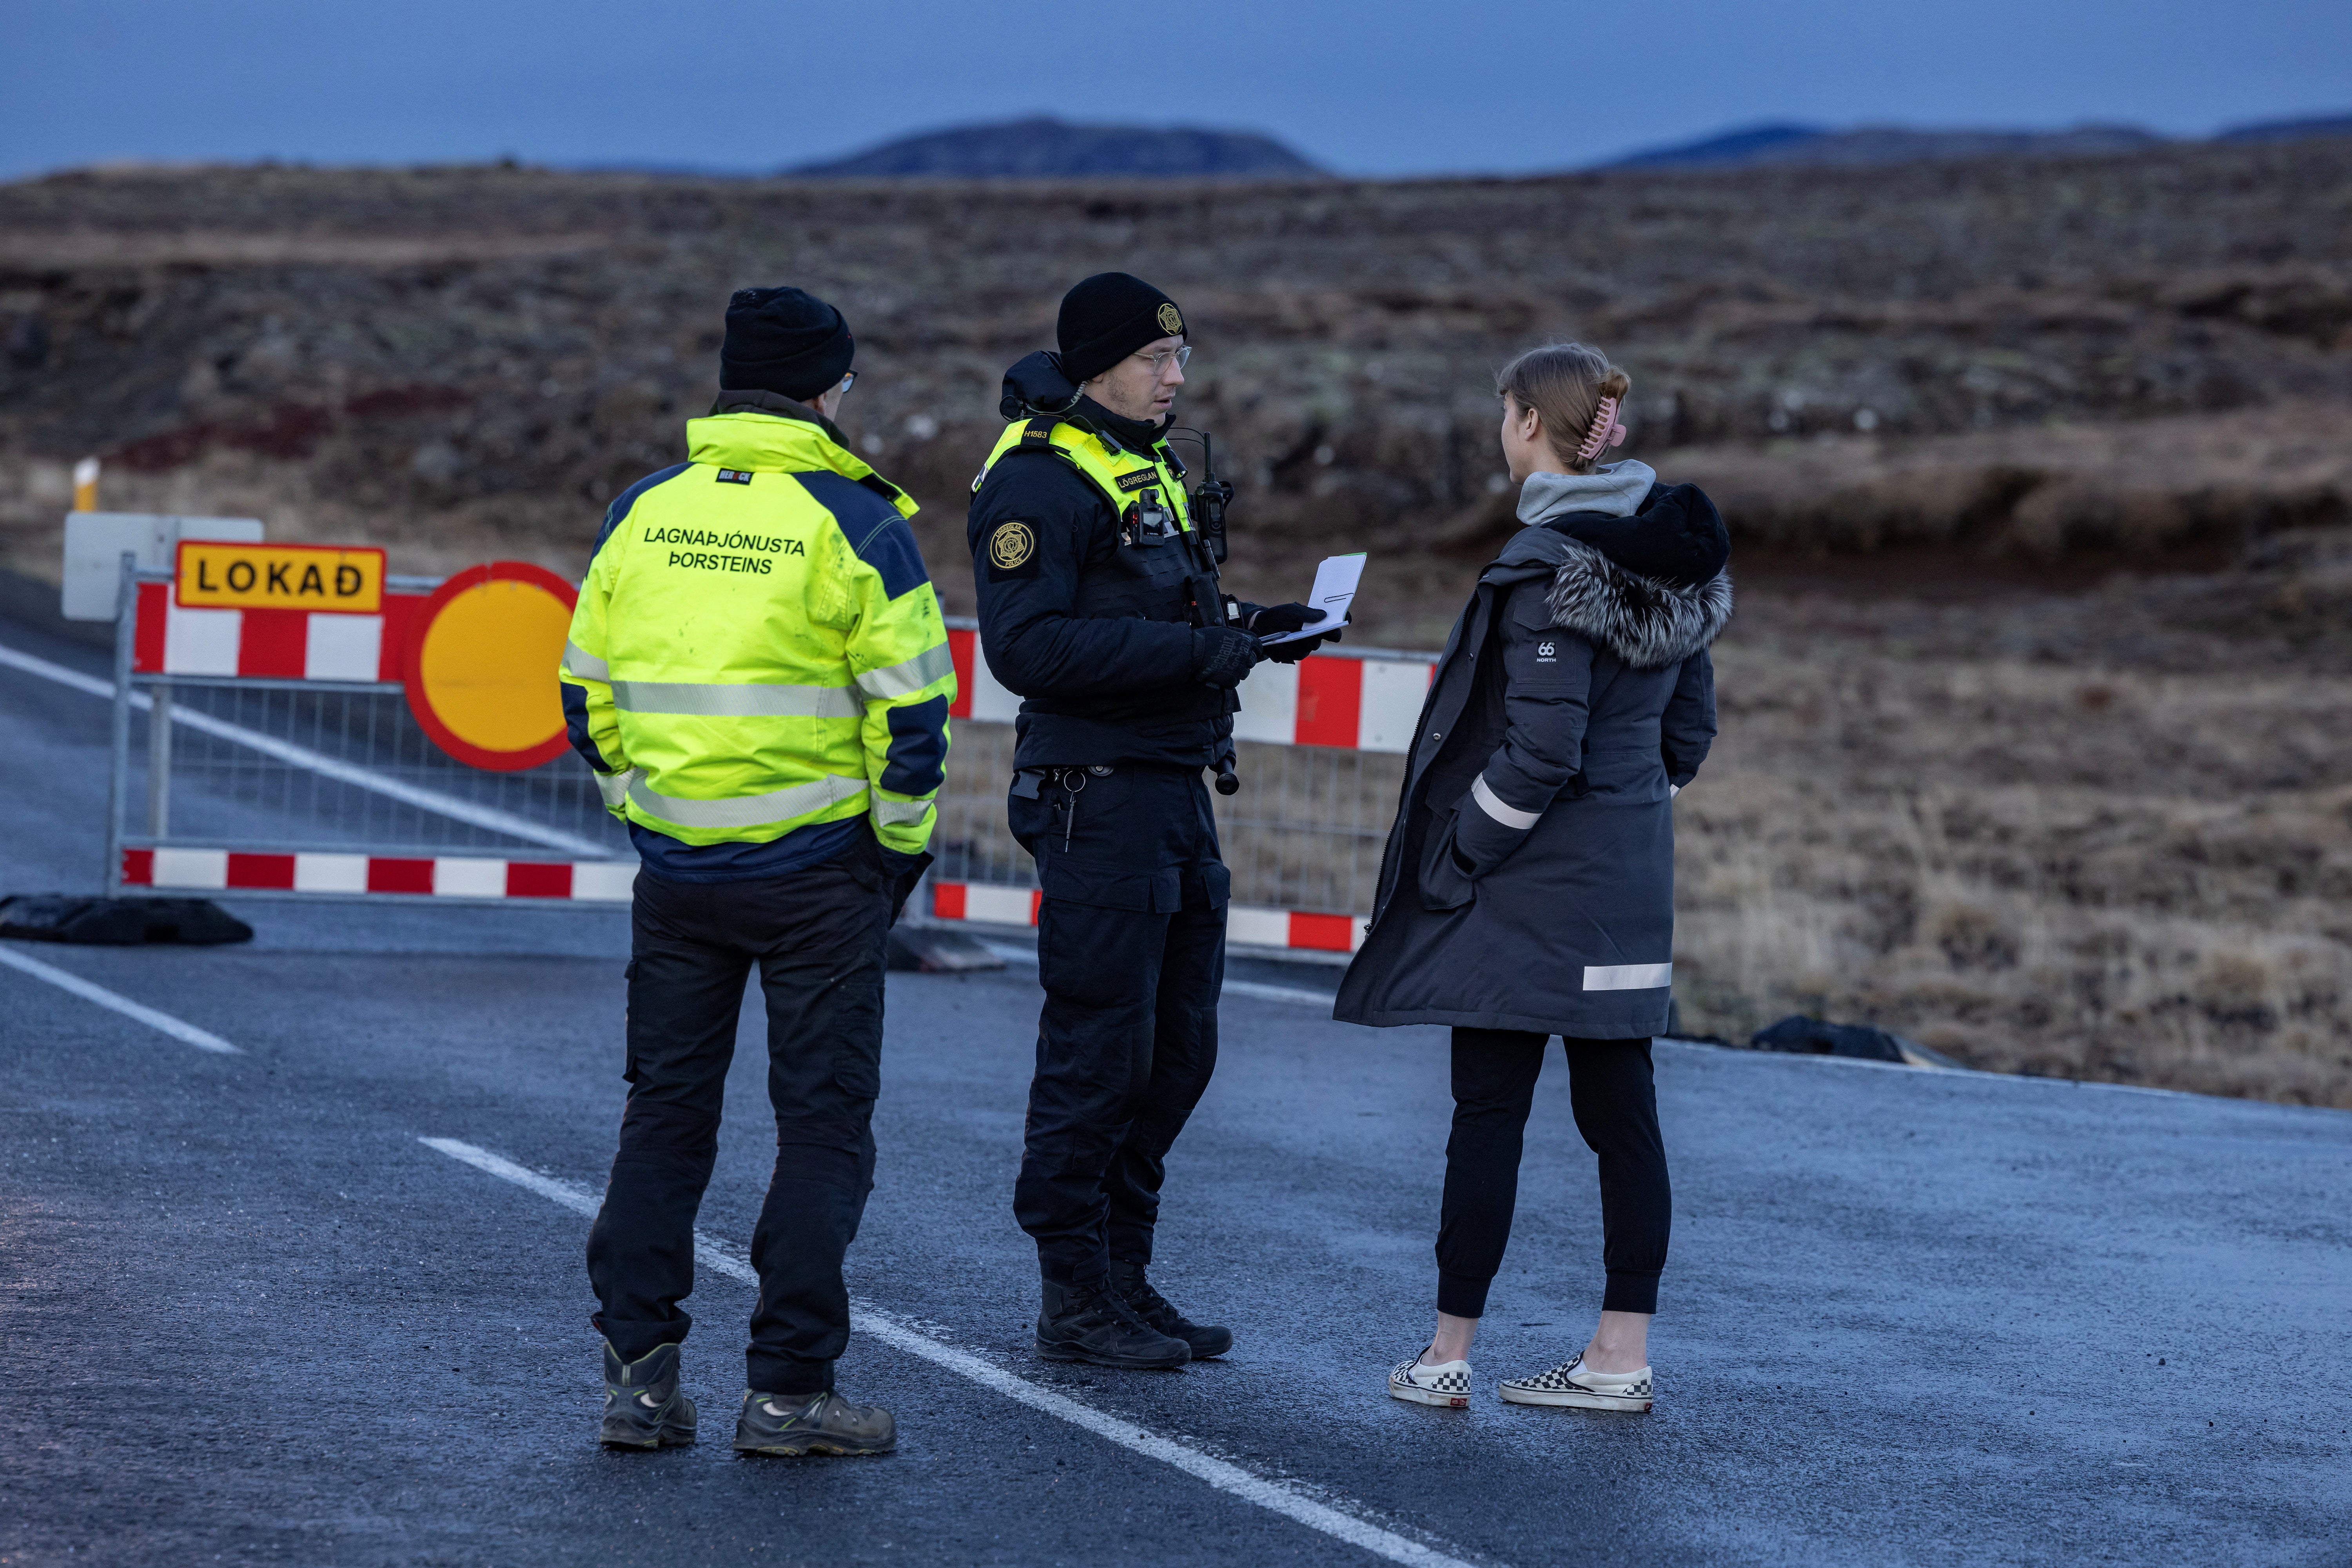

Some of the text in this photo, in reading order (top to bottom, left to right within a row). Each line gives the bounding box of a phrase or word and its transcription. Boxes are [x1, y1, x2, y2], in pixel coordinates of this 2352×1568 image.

[1118, 472, 1157, 488] LÖGREGLAN
[644, 528, 806, 557] LAGNAÞJÓNUSTA
[669, 552, 772, 574] ÞORSTEINS
[1005, 557, 1023, 566] POLICE
[199, 559, 363, 597] LOKAÐ
